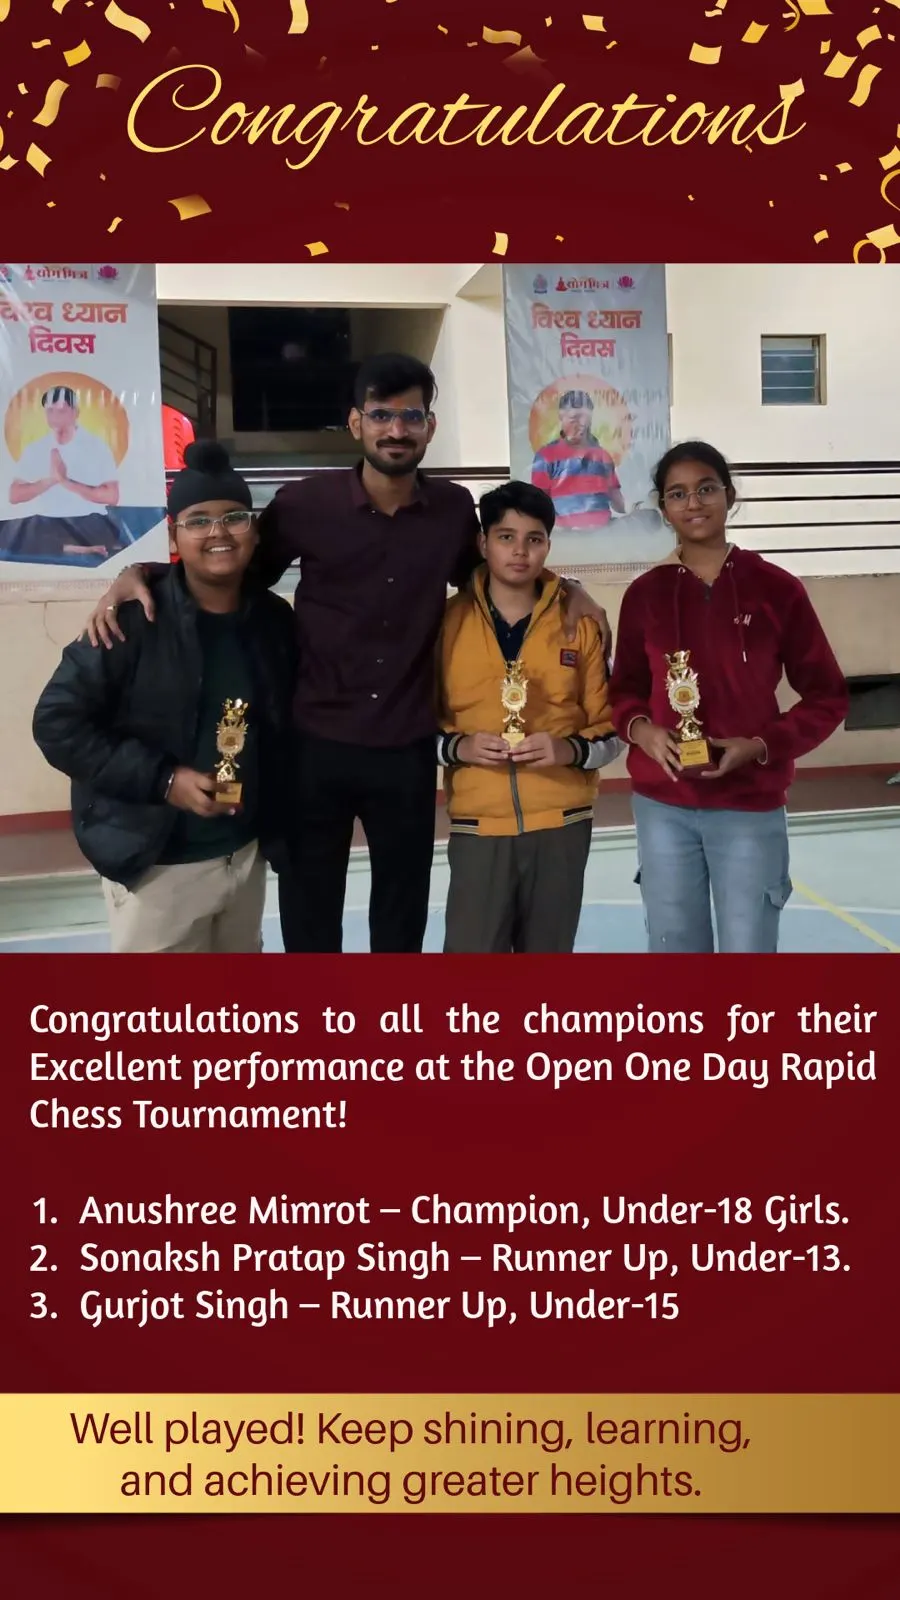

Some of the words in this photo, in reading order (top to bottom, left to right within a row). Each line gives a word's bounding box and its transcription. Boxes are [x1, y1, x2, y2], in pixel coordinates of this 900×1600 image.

[62, 301, 129, 324] ध्यान
[531, 303, 582, 329] विश्व
[588, 308, 643, 329] ध्यान
[28, 325, 97, 354] दिवस
[561, 332, 616, 358] दिवस
